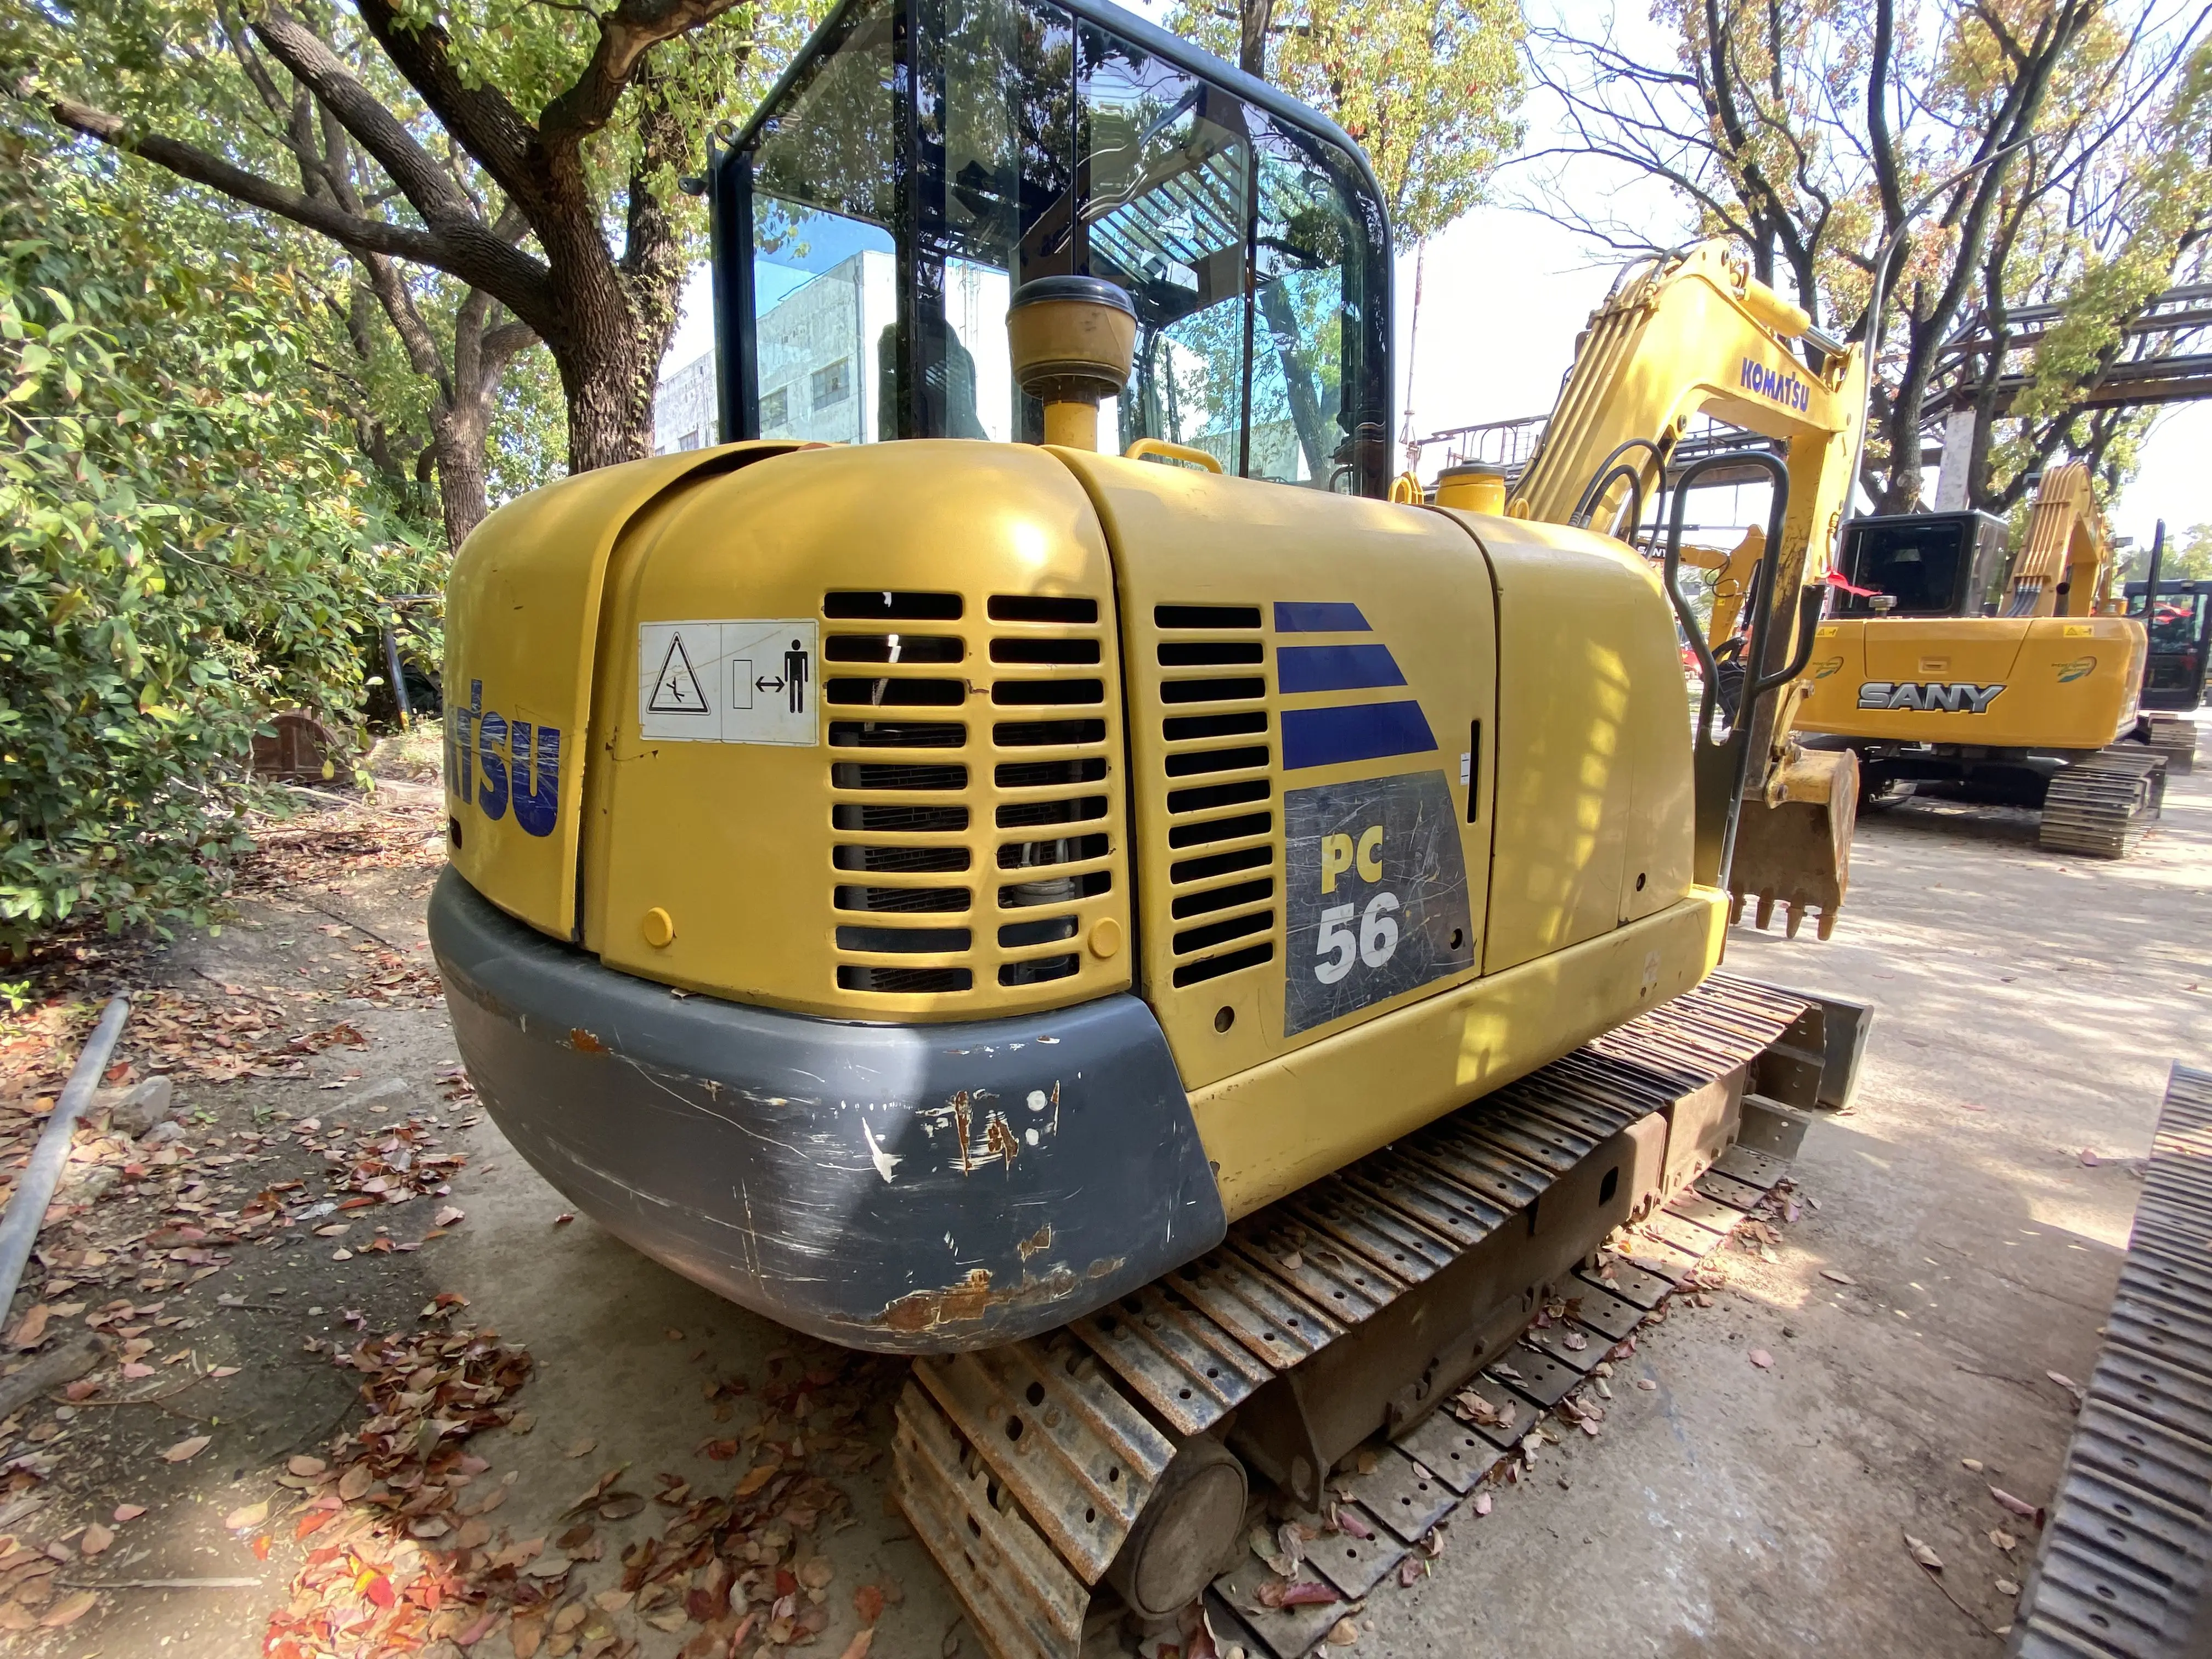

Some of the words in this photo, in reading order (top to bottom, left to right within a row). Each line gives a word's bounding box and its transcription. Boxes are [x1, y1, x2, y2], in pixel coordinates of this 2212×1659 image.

[1741, 357, 1810, 412] KOMATSU
[1858, 682, 2006, 714] SANY
[1321, 825, 1383, 894] PC
[1314, 891, 1400, 984] 56
